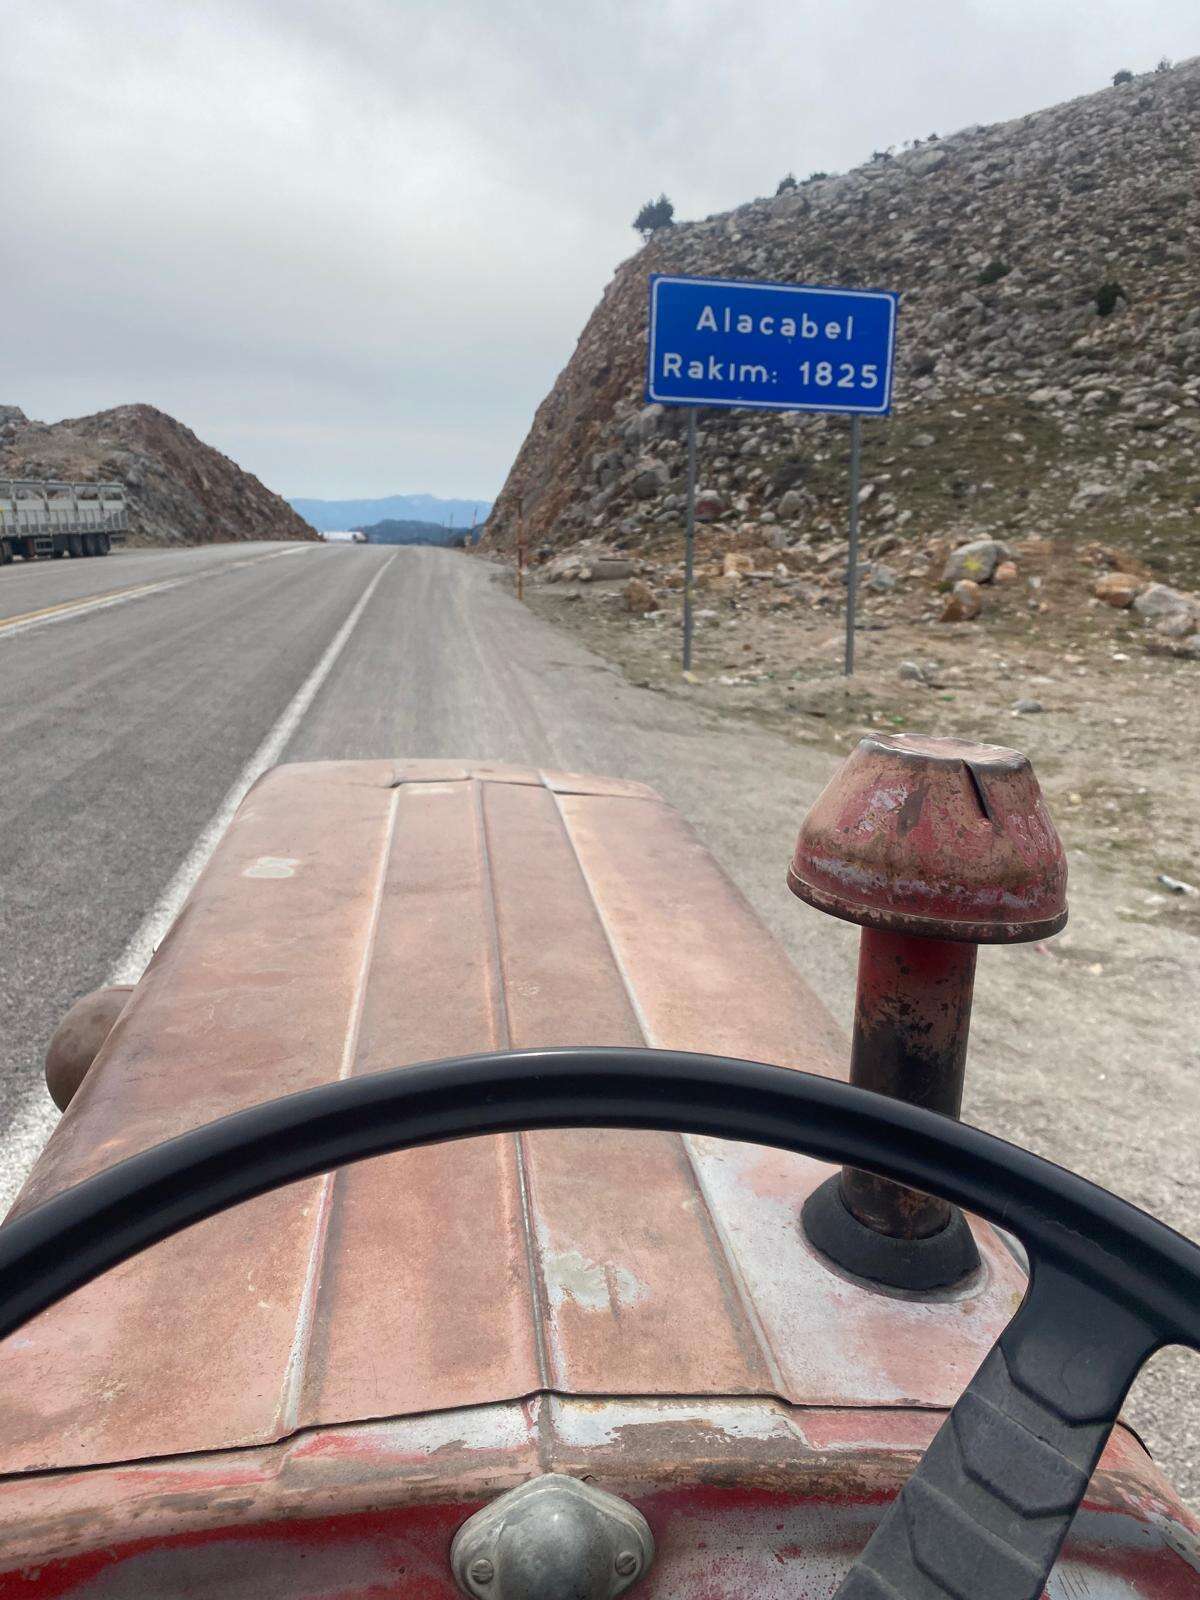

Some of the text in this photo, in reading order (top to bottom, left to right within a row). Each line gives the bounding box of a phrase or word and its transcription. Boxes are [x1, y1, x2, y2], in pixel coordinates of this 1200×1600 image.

[696, 305, 854, 341] Alacabel
[662, 352, 879, 389] Rakım: 1825
